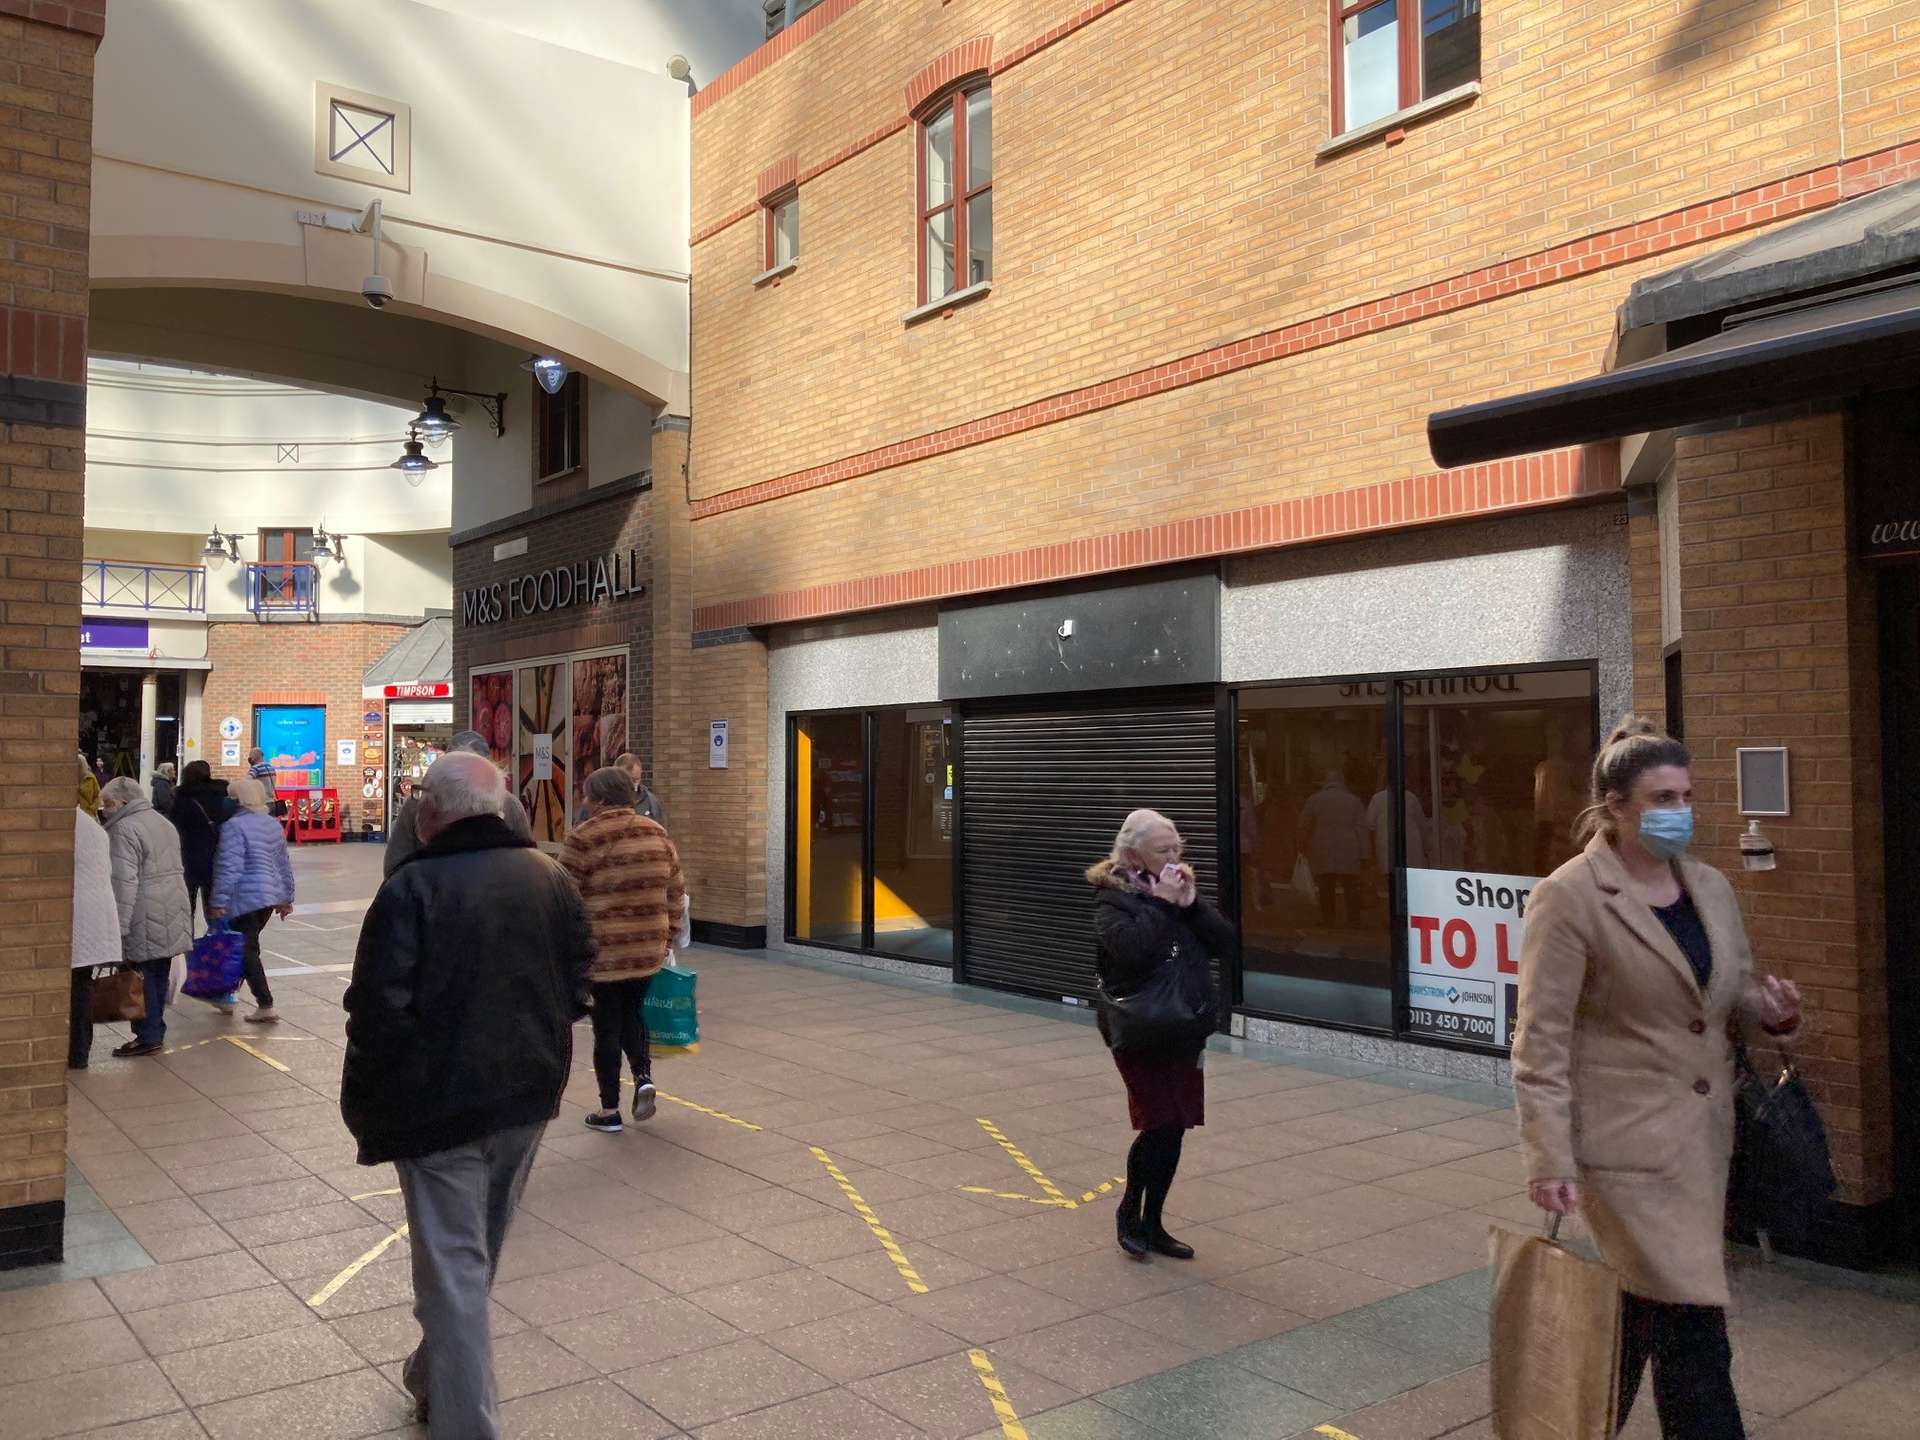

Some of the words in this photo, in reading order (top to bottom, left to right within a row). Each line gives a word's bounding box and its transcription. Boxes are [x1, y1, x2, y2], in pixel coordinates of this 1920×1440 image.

[463, 582, 503, 627] M&S
[509, 549, 645, 618] FOODHALL
[395, 685, 436, 697] TIMPSON
[1410, 915, 1477, 969] TO
[1461, 992, 1494, 1005] JOHNSON
[1436, 1014, 1459, 1030] 450
[1463, 1018, 1494, 1034] 7000
